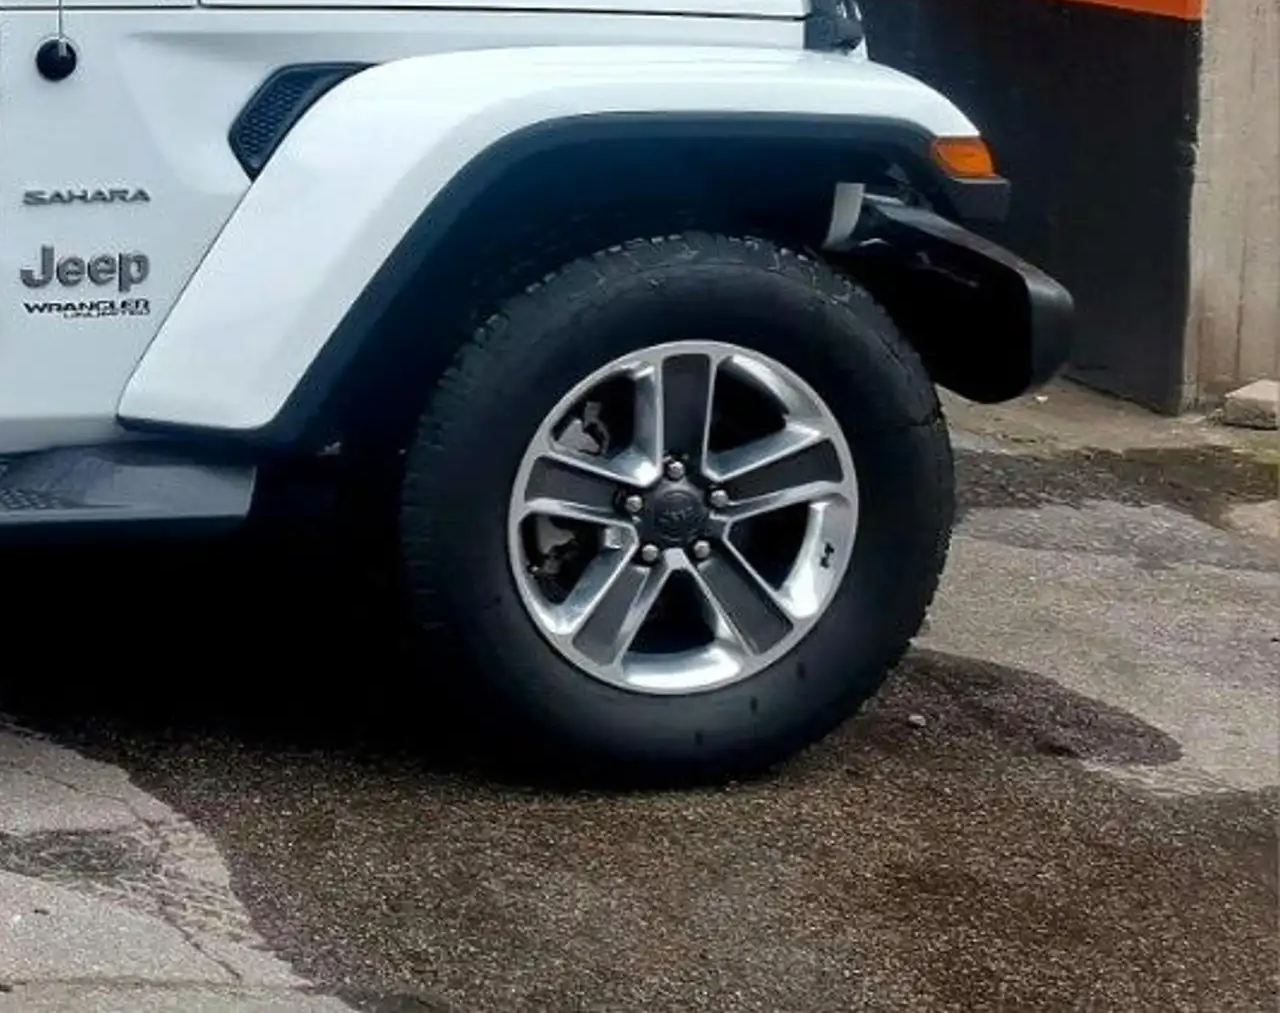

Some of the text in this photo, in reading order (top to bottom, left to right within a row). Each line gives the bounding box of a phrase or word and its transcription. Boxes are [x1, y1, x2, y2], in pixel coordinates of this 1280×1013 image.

[22, 189, 151, 205] SAHARA
[20, 245, 149, 293] Jeep
[23, 299, 150, 313] WRANGLER
